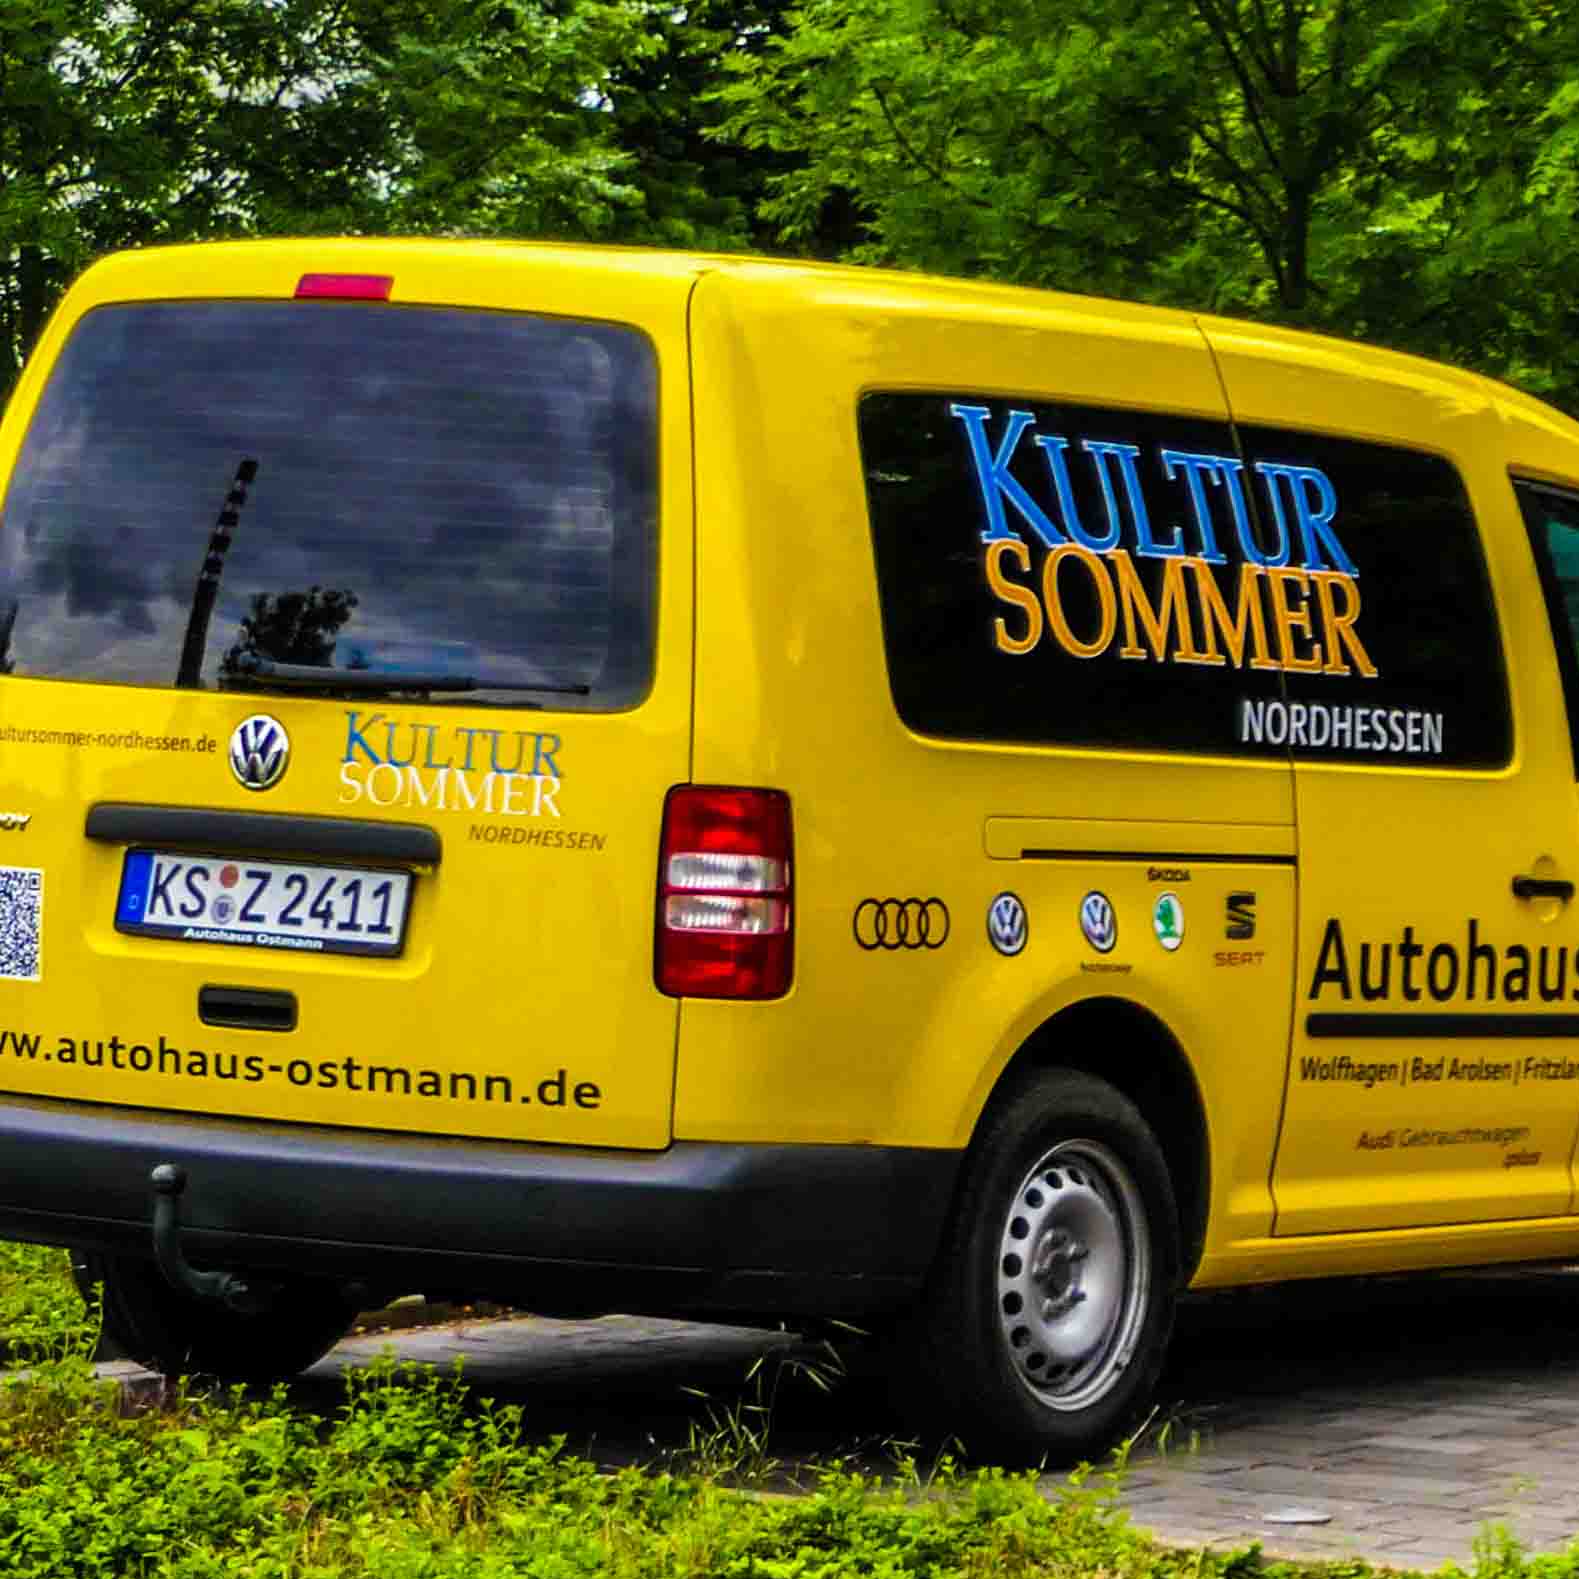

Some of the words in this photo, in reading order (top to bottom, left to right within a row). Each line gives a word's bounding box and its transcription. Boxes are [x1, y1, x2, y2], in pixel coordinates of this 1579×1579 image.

[951, 404, 1358, 578] KULTUR
[985, 539, 1379, 679] SOMMER
[340, 711, 564, 778] KULTUR
[1241, 700, 1443, 754] NORDHESSEN
[338, 761, 561, 817] SOMMER
[468, 824, 609, 852] NORDHESSEN
[149, 862, 209, 918] KS
[239, 870, 272, 923] Z
[278, 873, 394, 934] 2411
[184, 927, 253, 944] Autohaus
[256, 933, 323, 949] Ostmann
[1300, 1056, 1398, 1088] Wolfhagen
[1411, 1057, 1444, 1081] Bad
[1448, 1057, 1512, 1081] Arolsen
[1356, 1130, 1396, 1150] Audi
